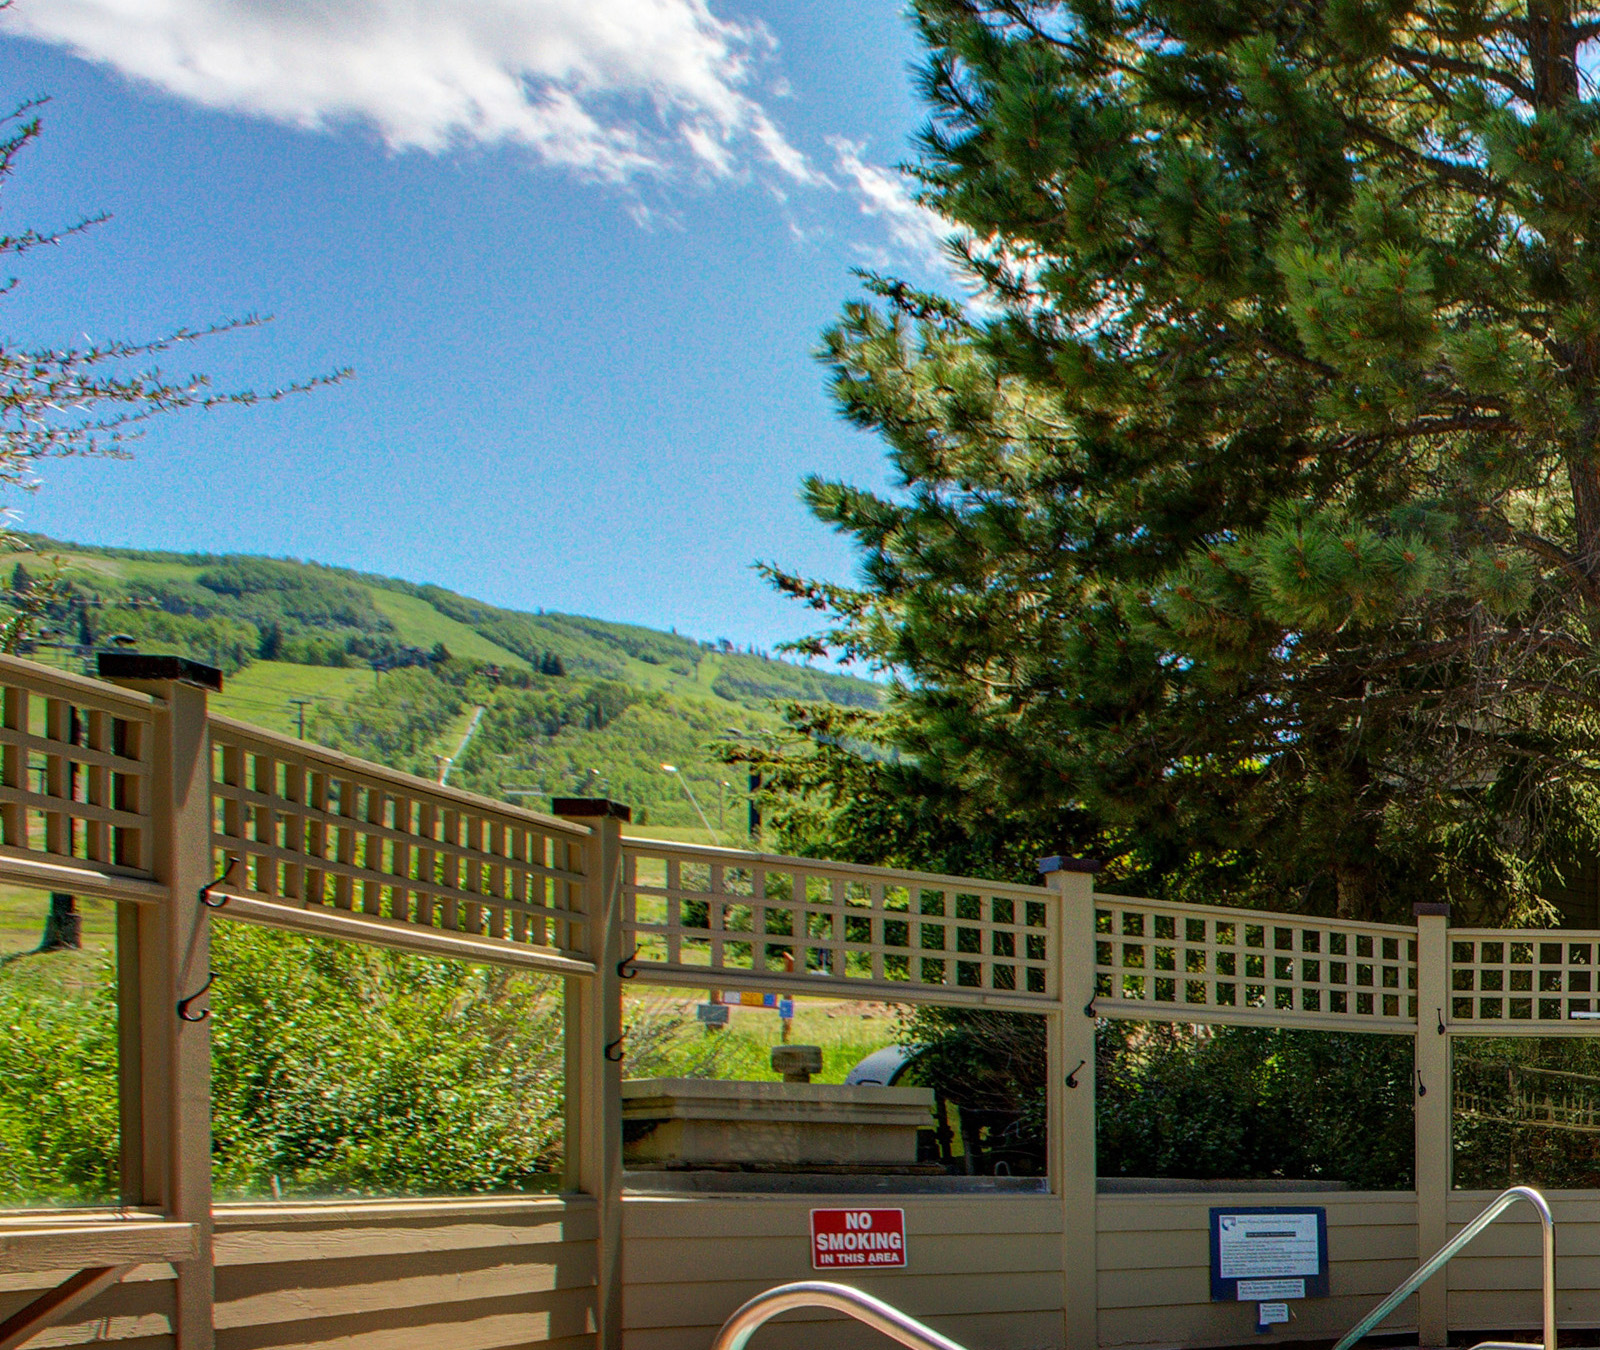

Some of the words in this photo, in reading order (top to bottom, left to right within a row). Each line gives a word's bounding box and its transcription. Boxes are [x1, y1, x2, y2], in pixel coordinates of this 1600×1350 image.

[845, 1212, 872, 1230] NO
[816, 1232, 901, 1250] SMOKING
[821, 1254, 834, 1263] IN
[837, 1253, 865, 1263] THIS
[868, 1253, 899, 1262] AREA
